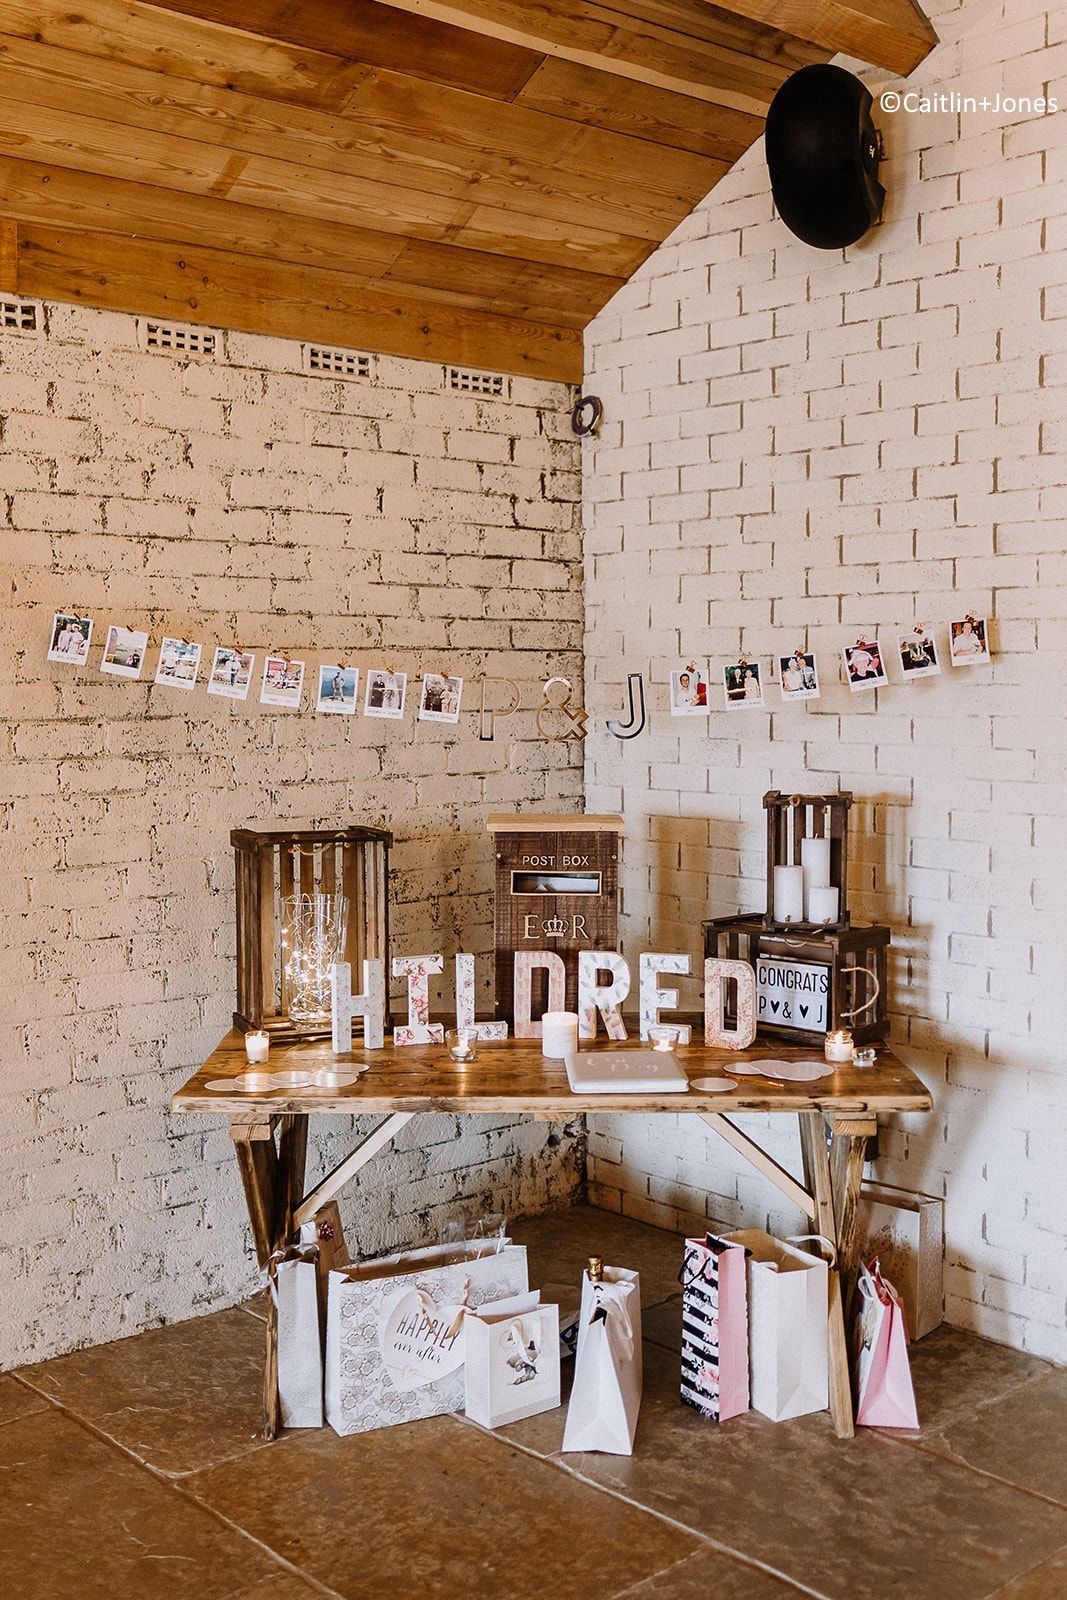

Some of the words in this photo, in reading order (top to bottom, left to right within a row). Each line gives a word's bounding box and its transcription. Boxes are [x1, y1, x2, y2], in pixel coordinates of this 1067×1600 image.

[606, 673, 645, 740] J
[522, 855, 556, 866] POST
[562, 855, 590, 866] BOX
[759, 966, 829, 993] CONGRATS
[331, 951, 757, 1053] HILDRED
[396, 1312, 461, 1351] HAPPILY
